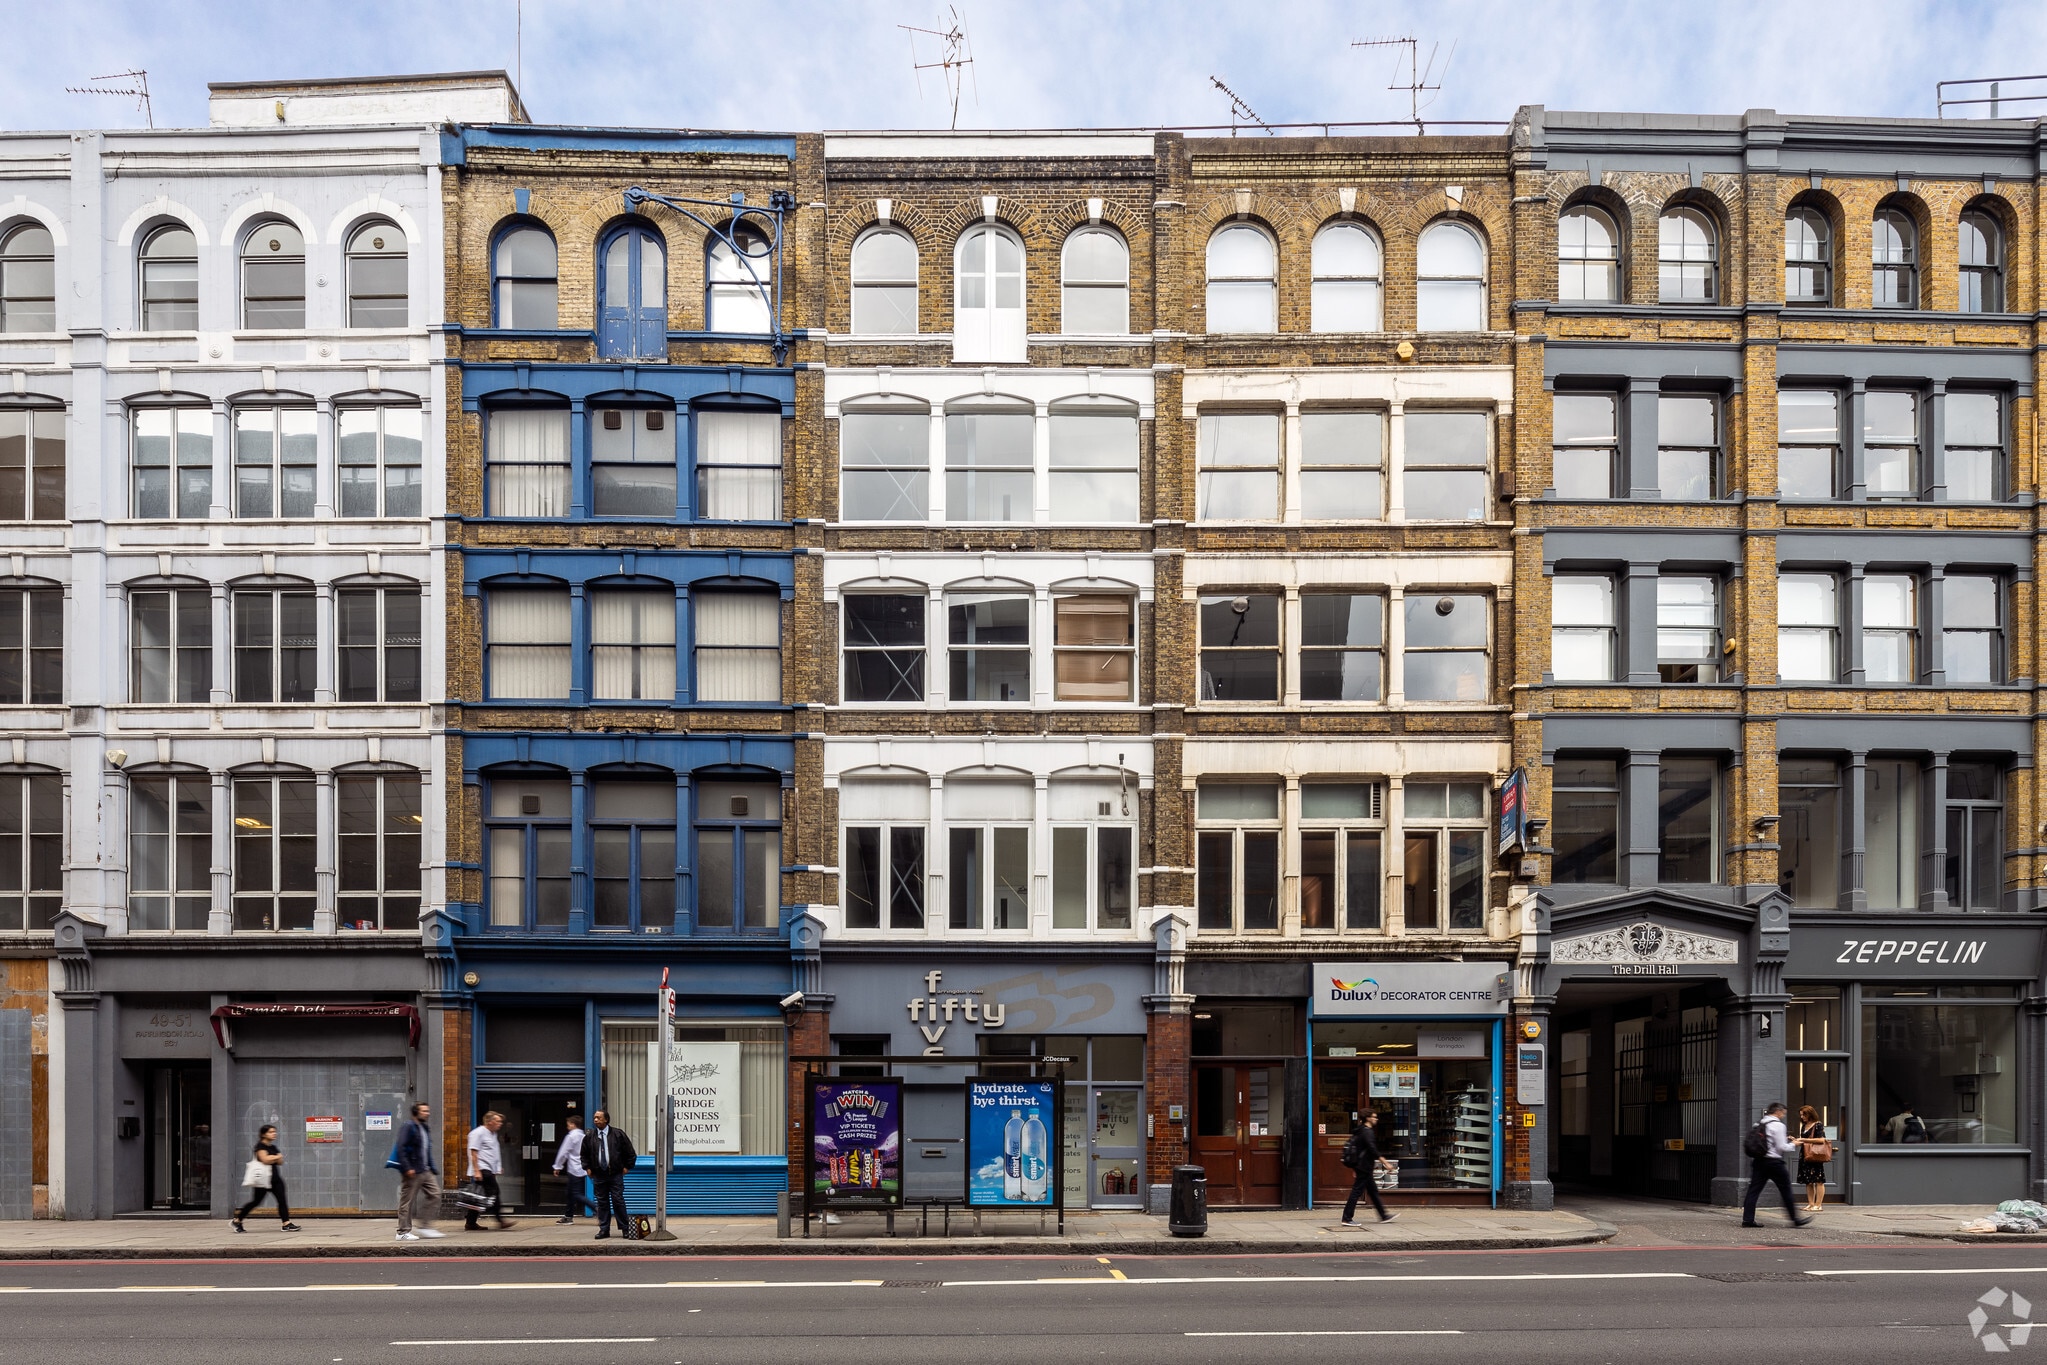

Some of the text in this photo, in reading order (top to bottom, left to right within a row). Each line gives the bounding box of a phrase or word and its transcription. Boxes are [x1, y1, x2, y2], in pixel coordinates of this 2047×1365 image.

[1836, 940, 1987, 964] ZEPPELIN
[1612, 965, 1679, 975] The Drill Hall
[1331, 988, 1374, 1001] Dulux
[1380, 991, 1447, 1001] DECORATOR
[1448, 991, 1492, 1001] CENTRE
[907, 997, 1005, 1027] fifty
[1436, 1034, 1463, 1043] London
[671, 1087, 717, 1096] LONDON
[973, 1083, 1027, 1095] hydrate.
[674, 1099, 715, 1108] BRIDGE
[837, 1094, 875, 1108] WIN
[973, 1095, 1040, 1108] bye thirst.
[674, 1124, 721, 1133] CADEMY
